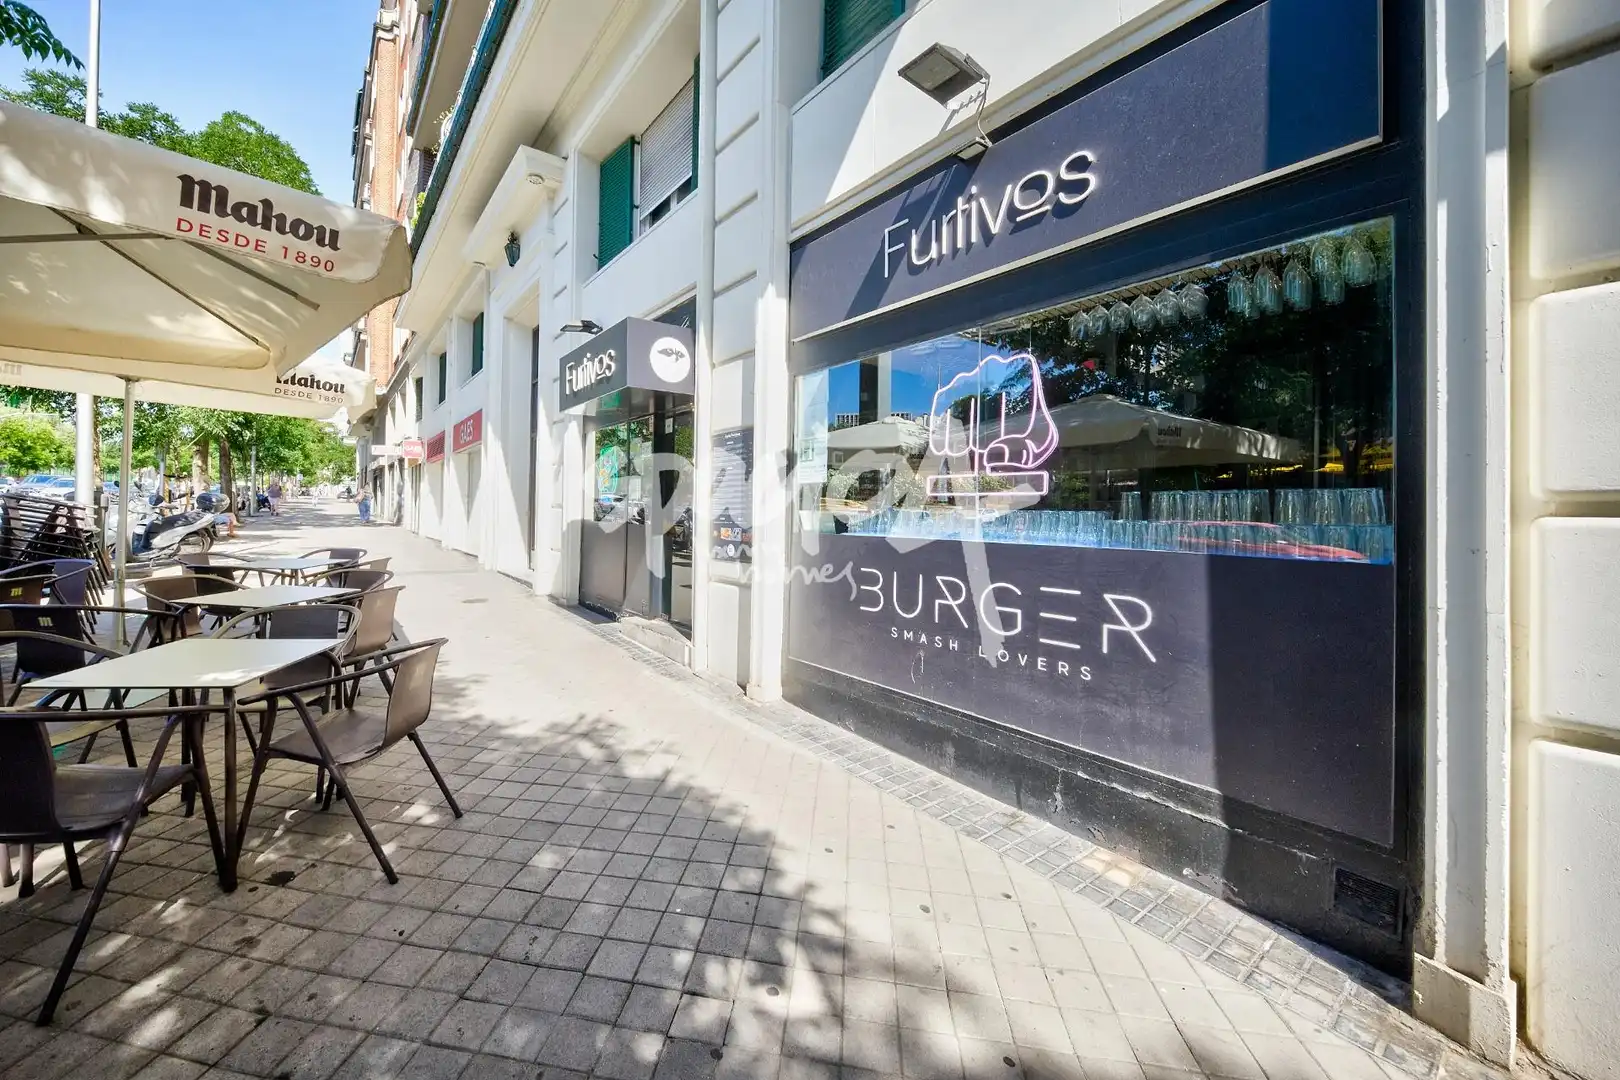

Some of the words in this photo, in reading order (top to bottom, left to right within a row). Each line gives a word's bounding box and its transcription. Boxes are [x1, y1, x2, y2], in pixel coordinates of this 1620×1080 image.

[177, 173, 341, 251] Mahou
[884, 150, 1096, 278] Furtivos
[176, 217, 268, 254] DESDE
[281, 245, 335, 272] 1890
[274, 387, 313, 400] DESDE
[318, 394, 344, 404] 1890
[565, 349, 616, 395] Furtivos
[859, 567, 1156, 663] BURGER
[890, 626, 959, 651] SMASH
[978, 646, 1092, 681] LOVERS
